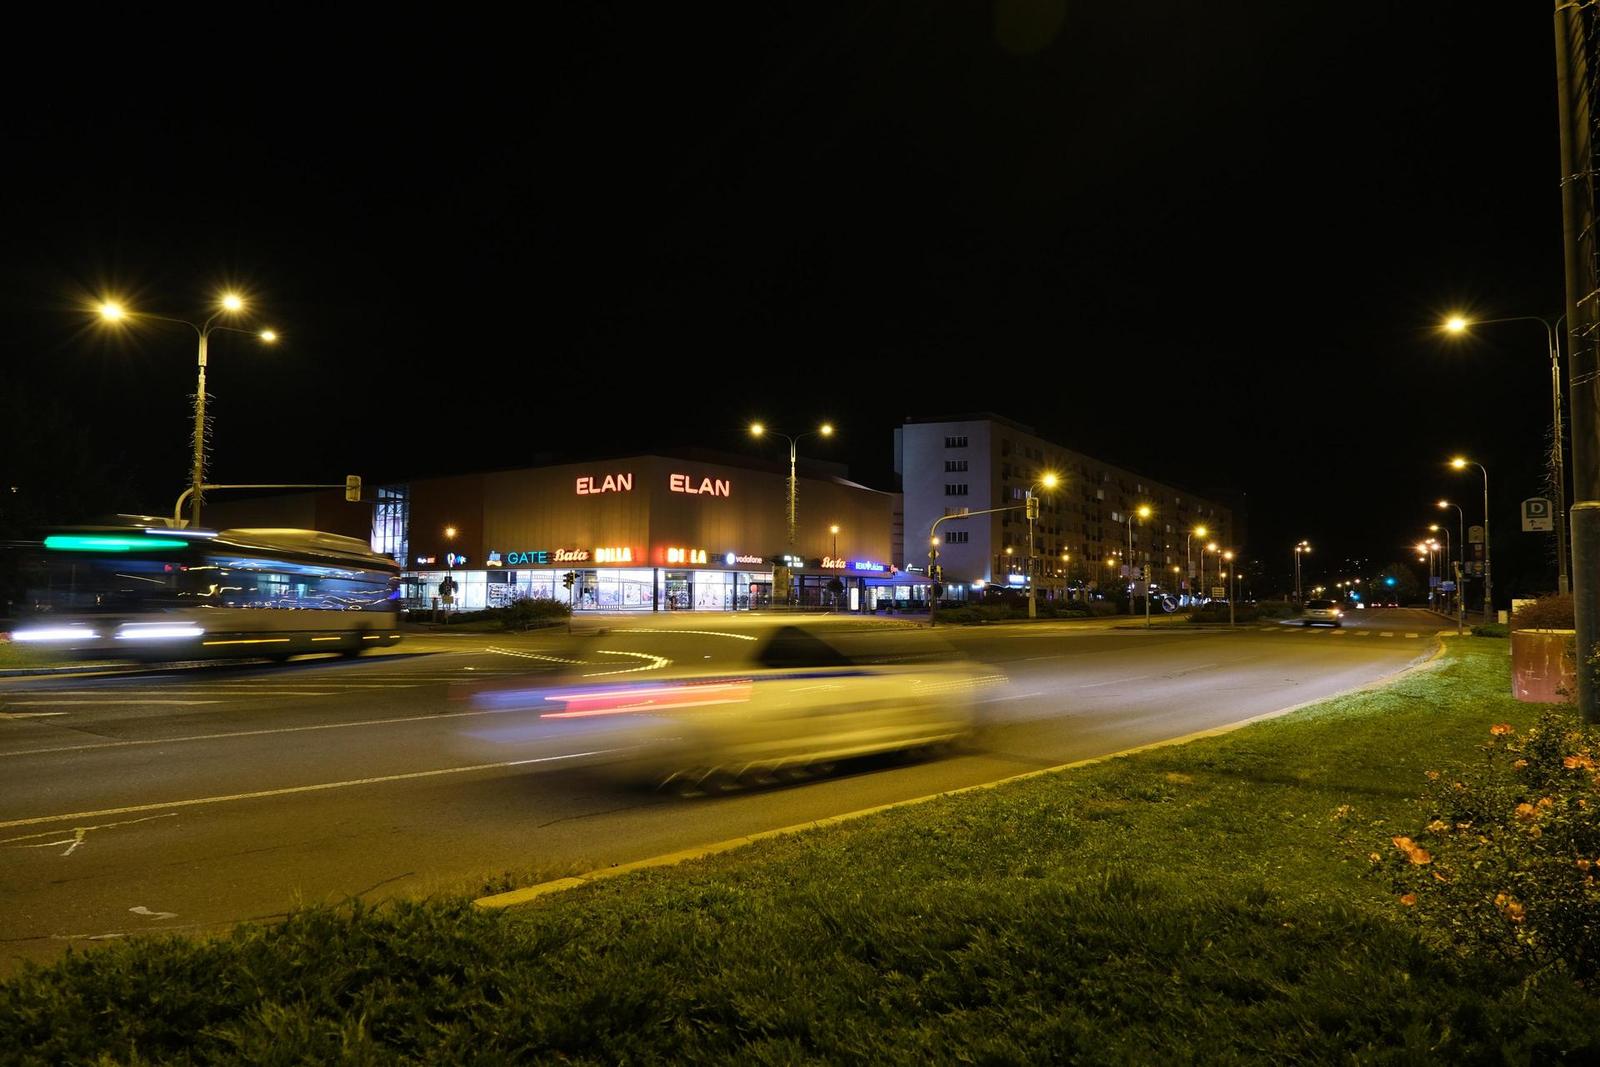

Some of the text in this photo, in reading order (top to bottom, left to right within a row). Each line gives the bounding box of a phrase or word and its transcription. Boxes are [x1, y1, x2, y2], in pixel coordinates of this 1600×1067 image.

[576, 473, 632, 495] ELAN
[669, 473, 730, 497] ELAN
[1531, 503, 1544, 513] D
[507, 551, 548, 565] GATE
[595, 547, 632, 563] BILLA
[735, 554, 763, 564] vodafone
